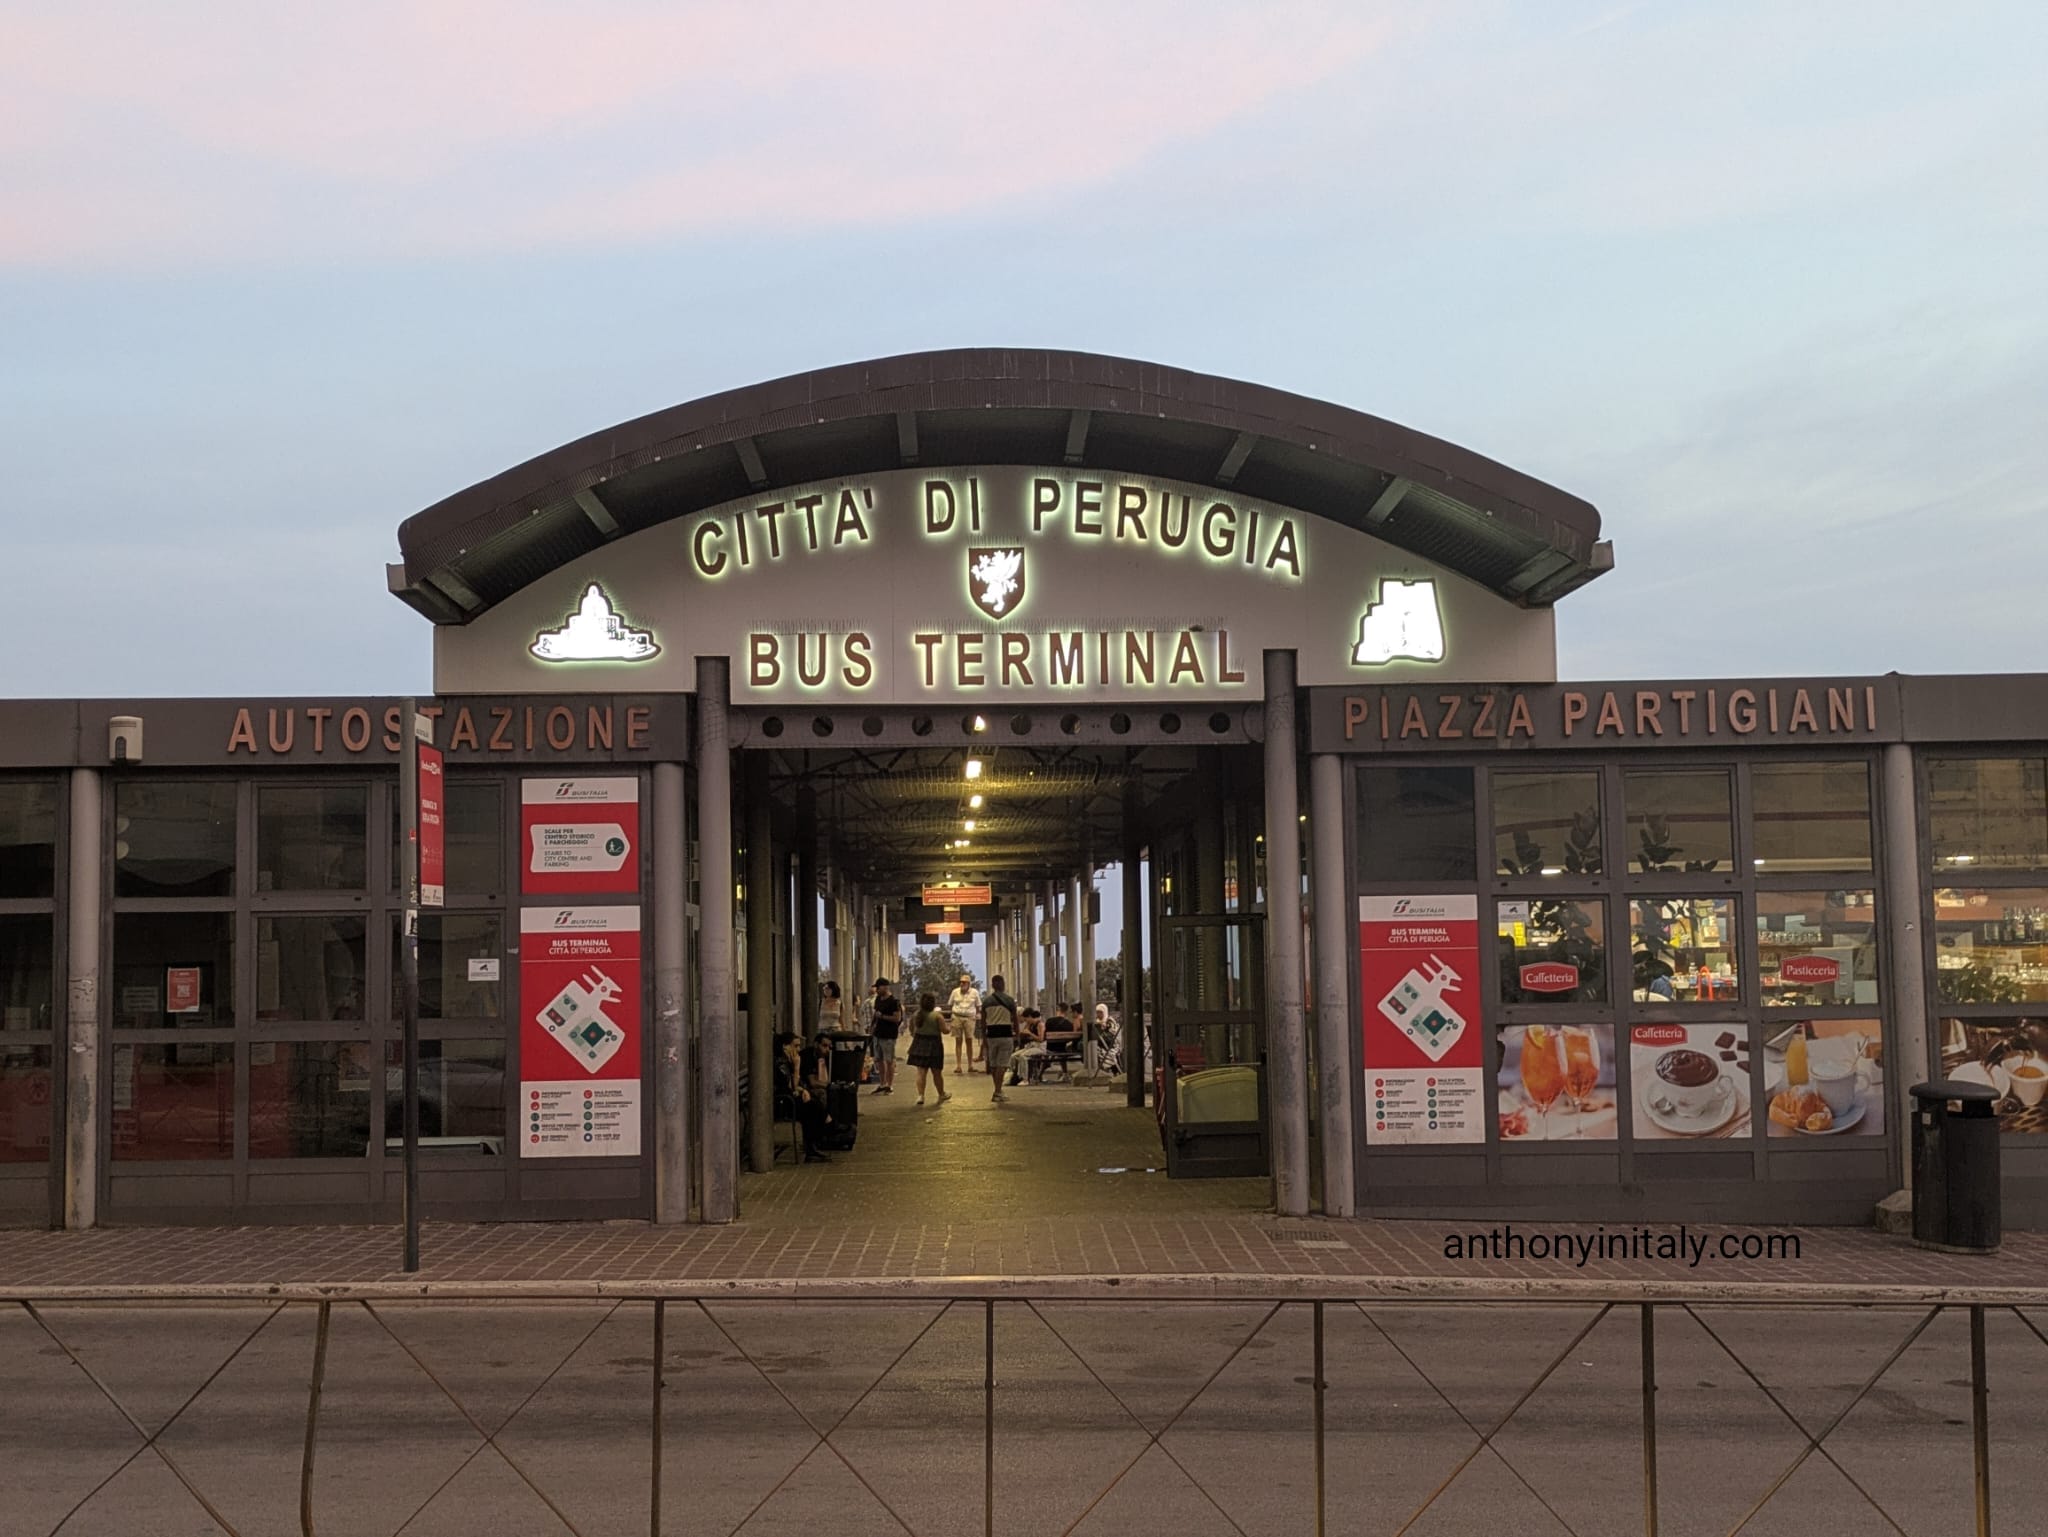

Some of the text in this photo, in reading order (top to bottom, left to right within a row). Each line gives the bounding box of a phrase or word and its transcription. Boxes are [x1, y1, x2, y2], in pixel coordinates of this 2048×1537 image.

[693, 478, 1301, 576] CITTA' DI PERUGIA
[749, 631, 1245, 687] BUS TERMINAL
[1344, 687, 1877, 740] PIAZZA PARTIGIANI
[1391, 927, 1447, 936] BUS TERMINAL
[552, 938, 609, 947] BUS TERMINAL
[1419, 935, 1450, 943] PERUGIA
[579, 946, 612, 954] PERUGIA
[1786, 964, 1836, 977] Pasticceria
[1525, 971, 1574, 985] Caffetteria
[1634, 1027, 1683, 1040] Caffetteria
